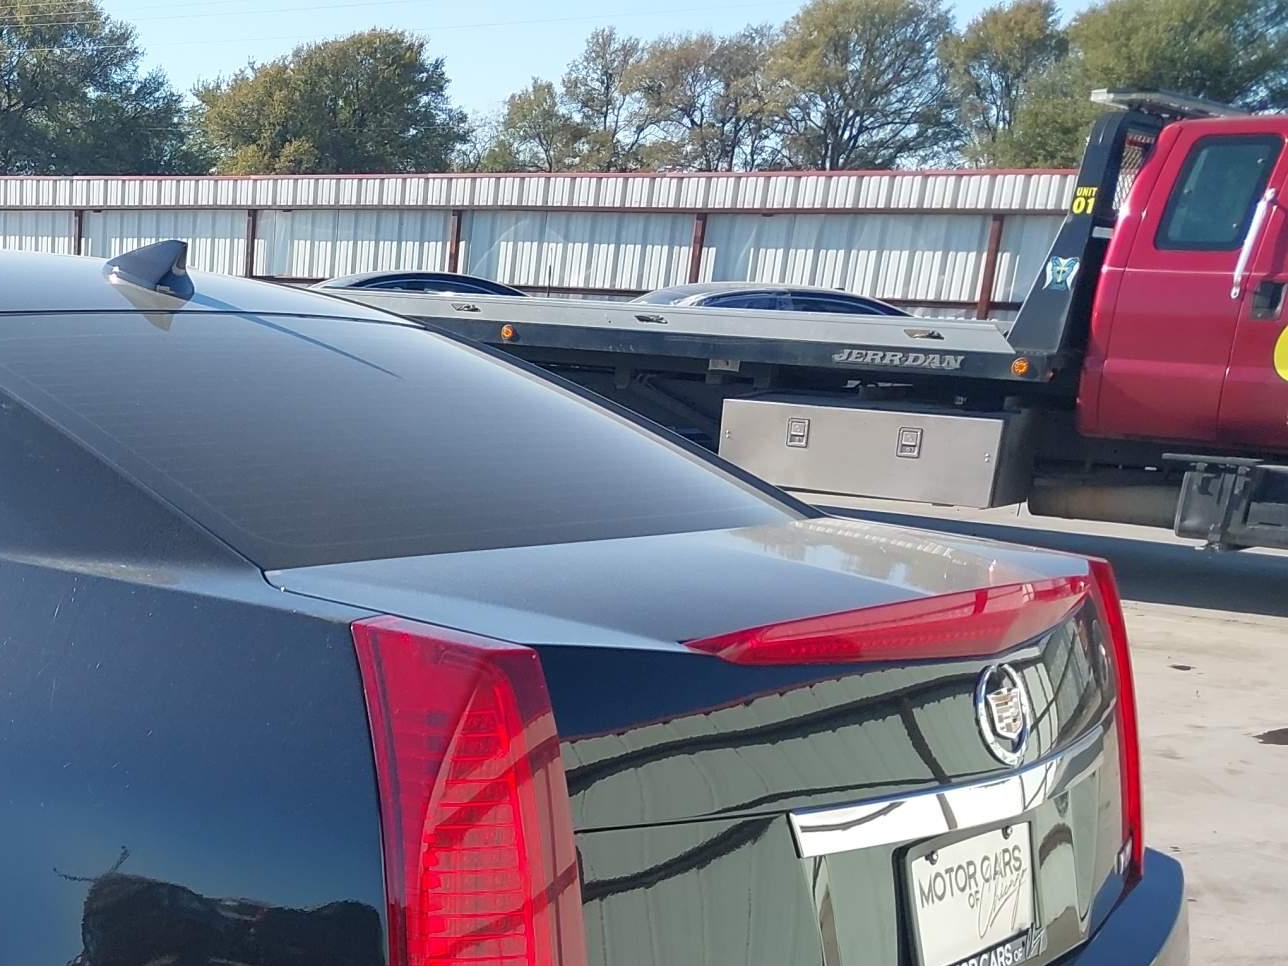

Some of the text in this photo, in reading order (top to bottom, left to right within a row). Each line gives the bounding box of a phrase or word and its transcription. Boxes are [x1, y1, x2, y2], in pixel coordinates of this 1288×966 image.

[1076, 186, 1098, 197] UNIT
[1072, 196, 1096, 214] 01
[918, 859, 979, 909] MOTOR
[979, 844, 1023, 883] CARS
[968, 889, 981, 909] OF
[1012, 946, 1024, 963] OF
